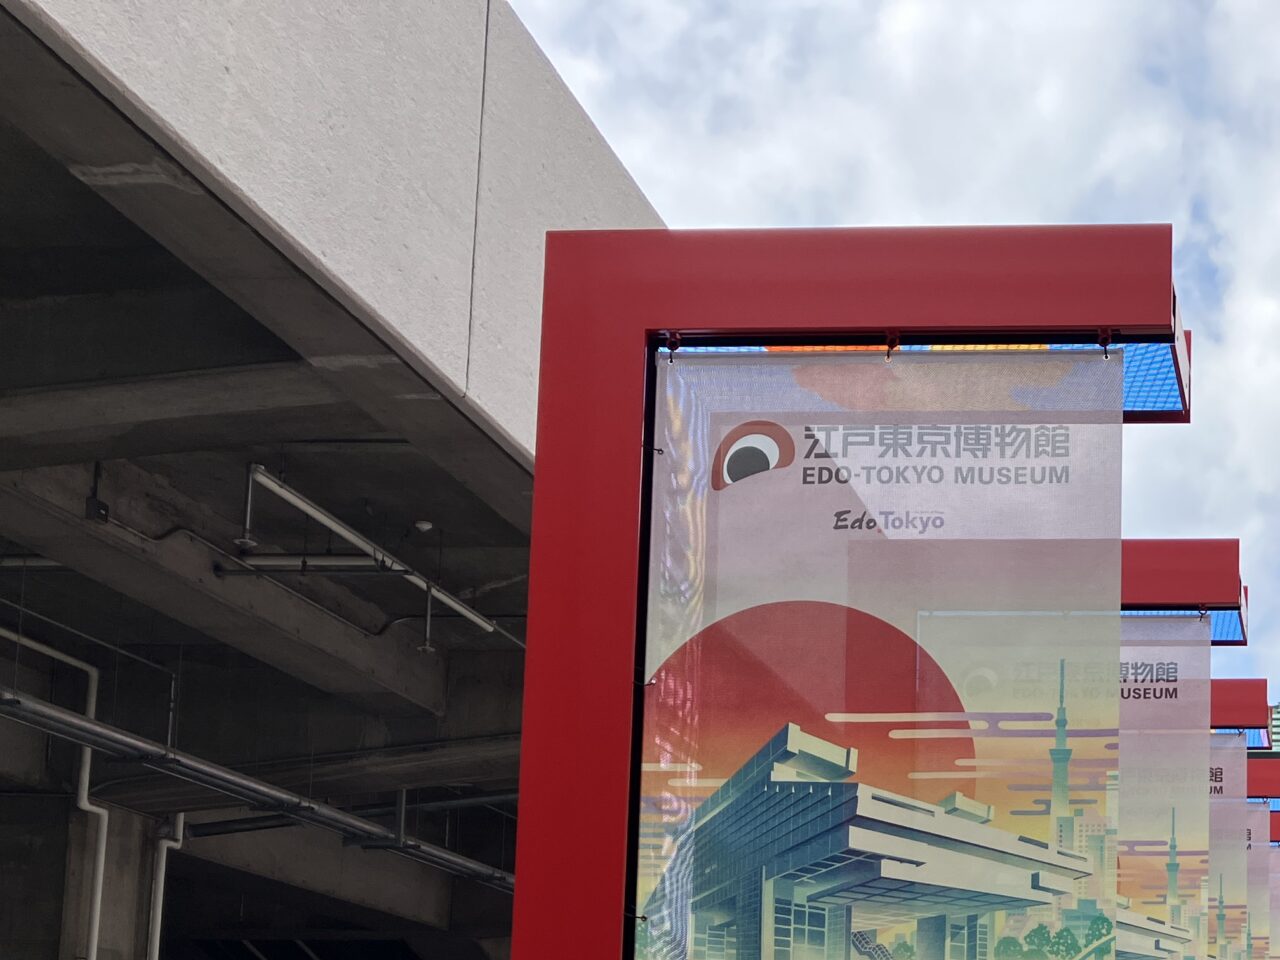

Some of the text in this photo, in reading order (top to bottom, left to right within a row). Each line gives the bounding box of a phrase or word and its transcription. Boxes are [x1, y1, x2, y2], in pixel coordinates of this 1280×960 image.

[803, 424, 1070, 459] 江戸東京博物館
[802, 466, 1070, 485] EDO-TOKYO MUSEUM
